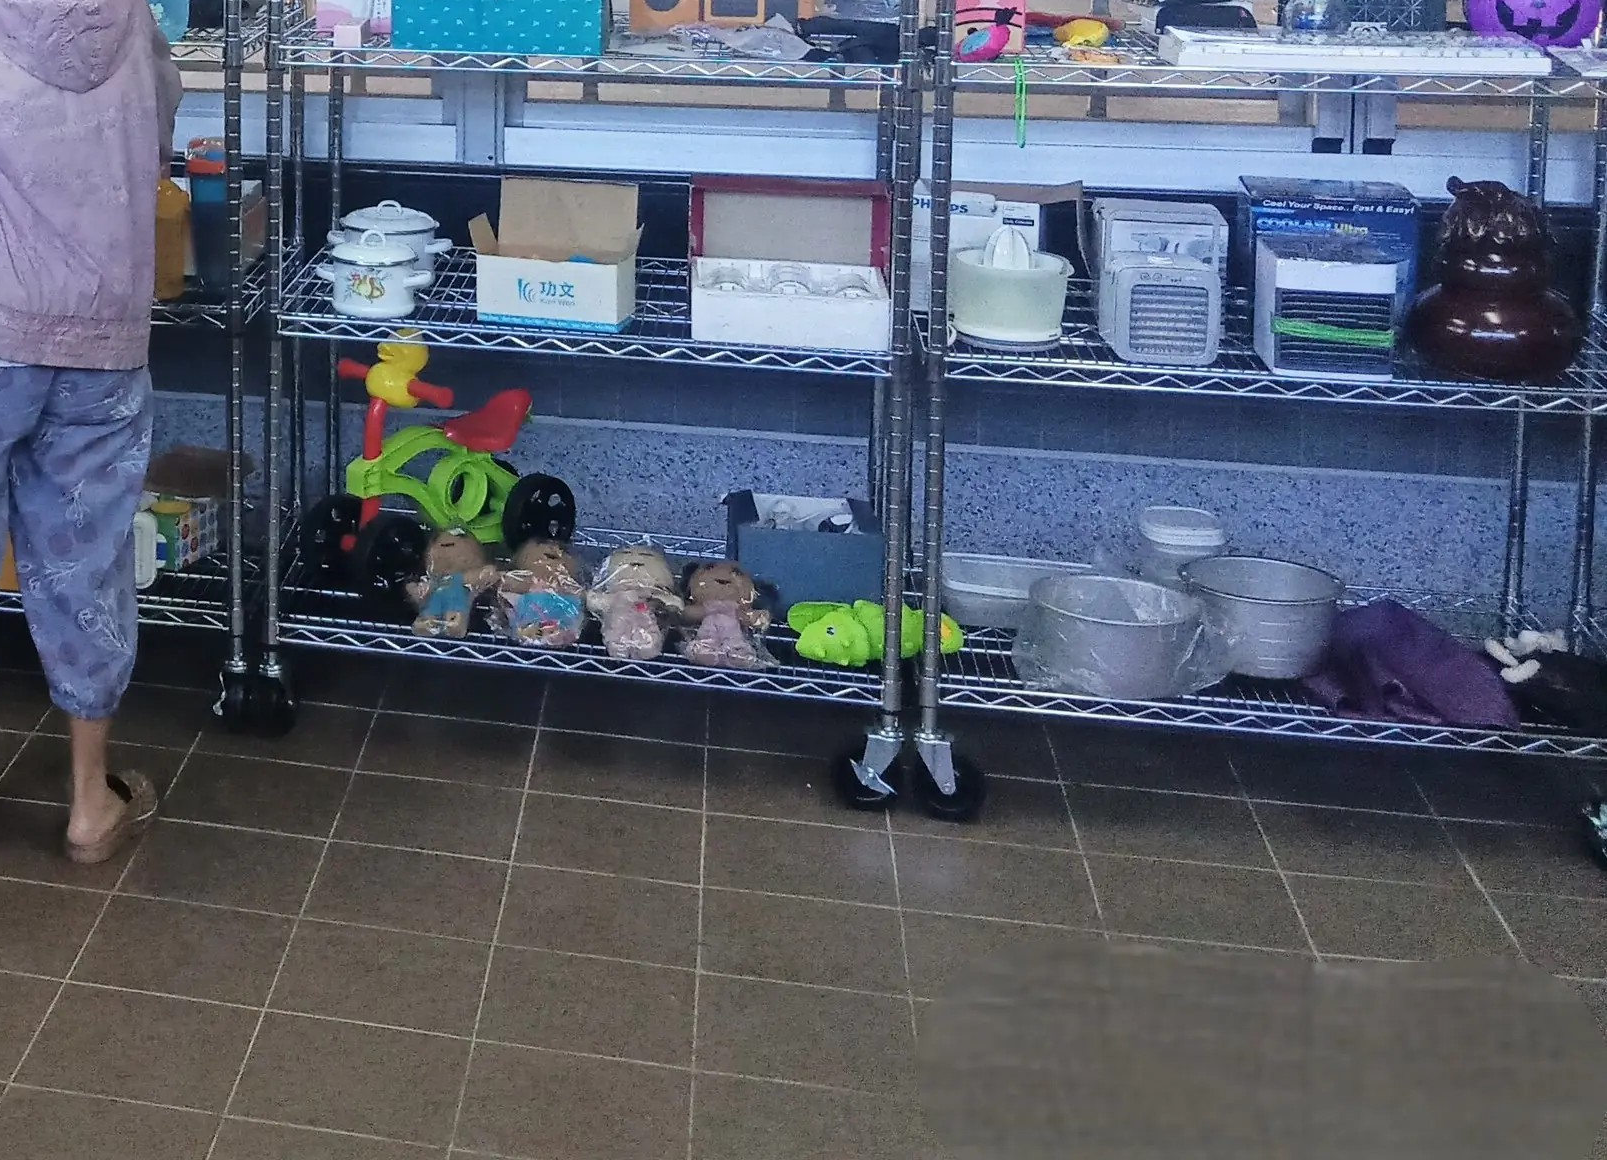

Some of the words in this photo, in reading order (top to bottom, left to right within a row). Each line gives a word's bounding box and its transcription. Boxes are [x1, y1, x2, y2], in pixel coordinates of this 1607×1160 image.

[1262, 199, 1287, 208] Cool
[1288, 201, 1312, 209] Your
[1352, 204, 1376, 212] Fast
[1385, 206, 1416, 215] Easy!
[539, 280, 575, 298] 功文
